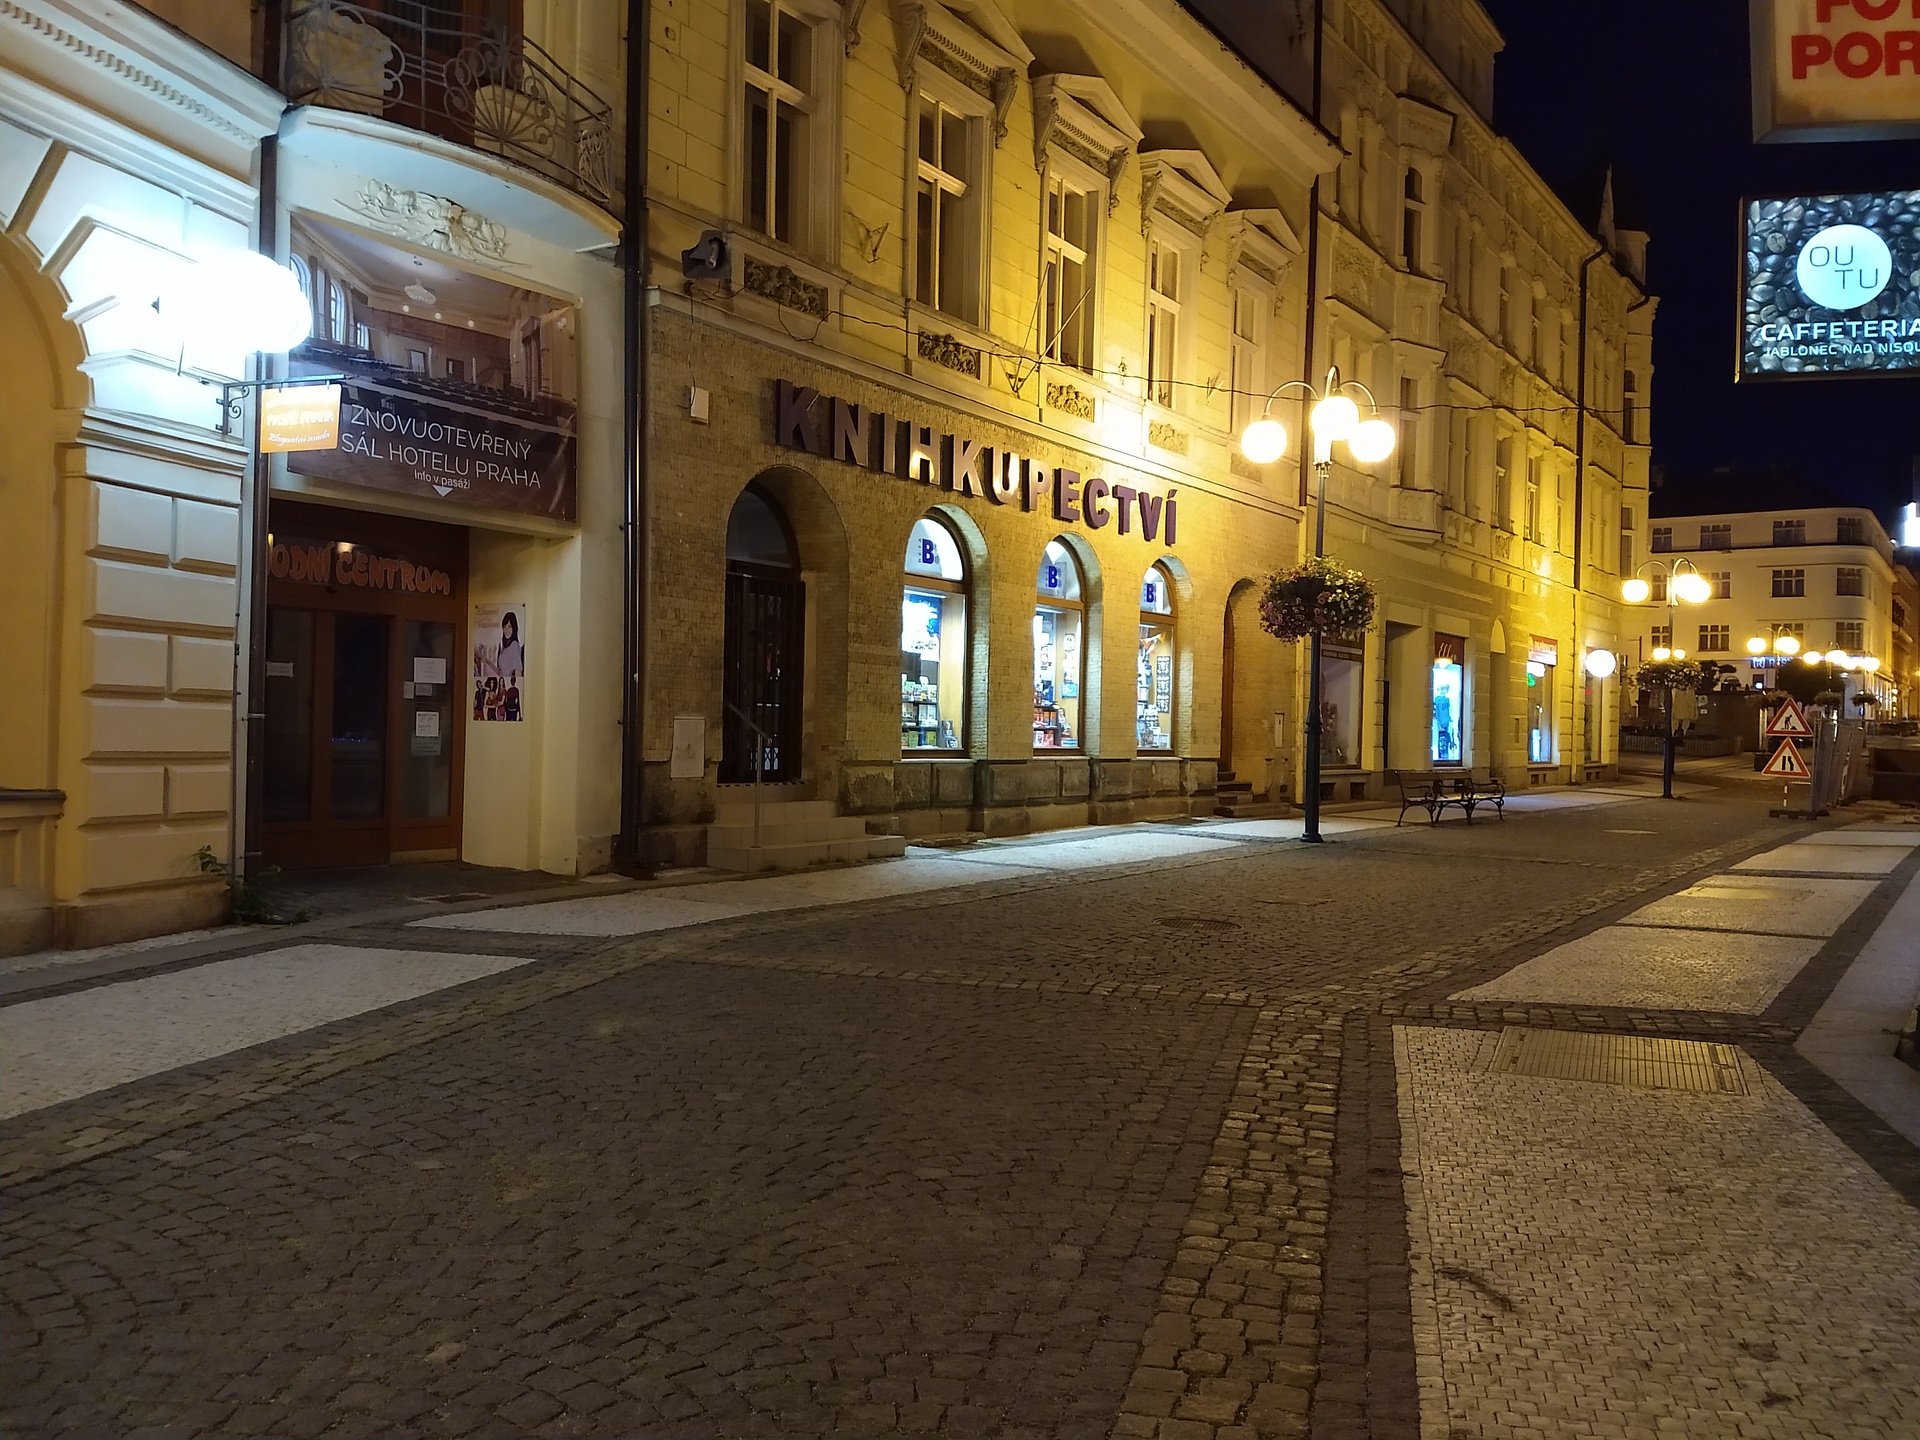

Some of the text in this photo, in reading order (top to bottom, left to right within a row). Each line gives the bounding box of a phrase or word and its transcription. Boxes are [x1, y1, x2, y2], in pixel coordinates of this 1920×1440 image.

[1809, 245, 1854, 267] OU
[1834, 268, 1879, 289] TU
[1761, 318, 1920, 341] CAFFETERIA
[1764, 344, 1838, 357] JABLONEC
[1842, 343, 1873, 355] NAD
[351, 404, 532, 461] ZNOVUOTEVŘENÝ
[341, 431, 541, 489] SÁL HOTELU PRAHA
[776, 377, 1179, 547] KNIHKUPECTVÍ
[414, 469, 431, 482] Info
[433, 475, 439, 484] v
[922, 538, 935, 565] B
[336, 551, 451, 595] CENTRUM
[1048, 565, 1058, 588] B
[1146, 583, 1155, 602] B
